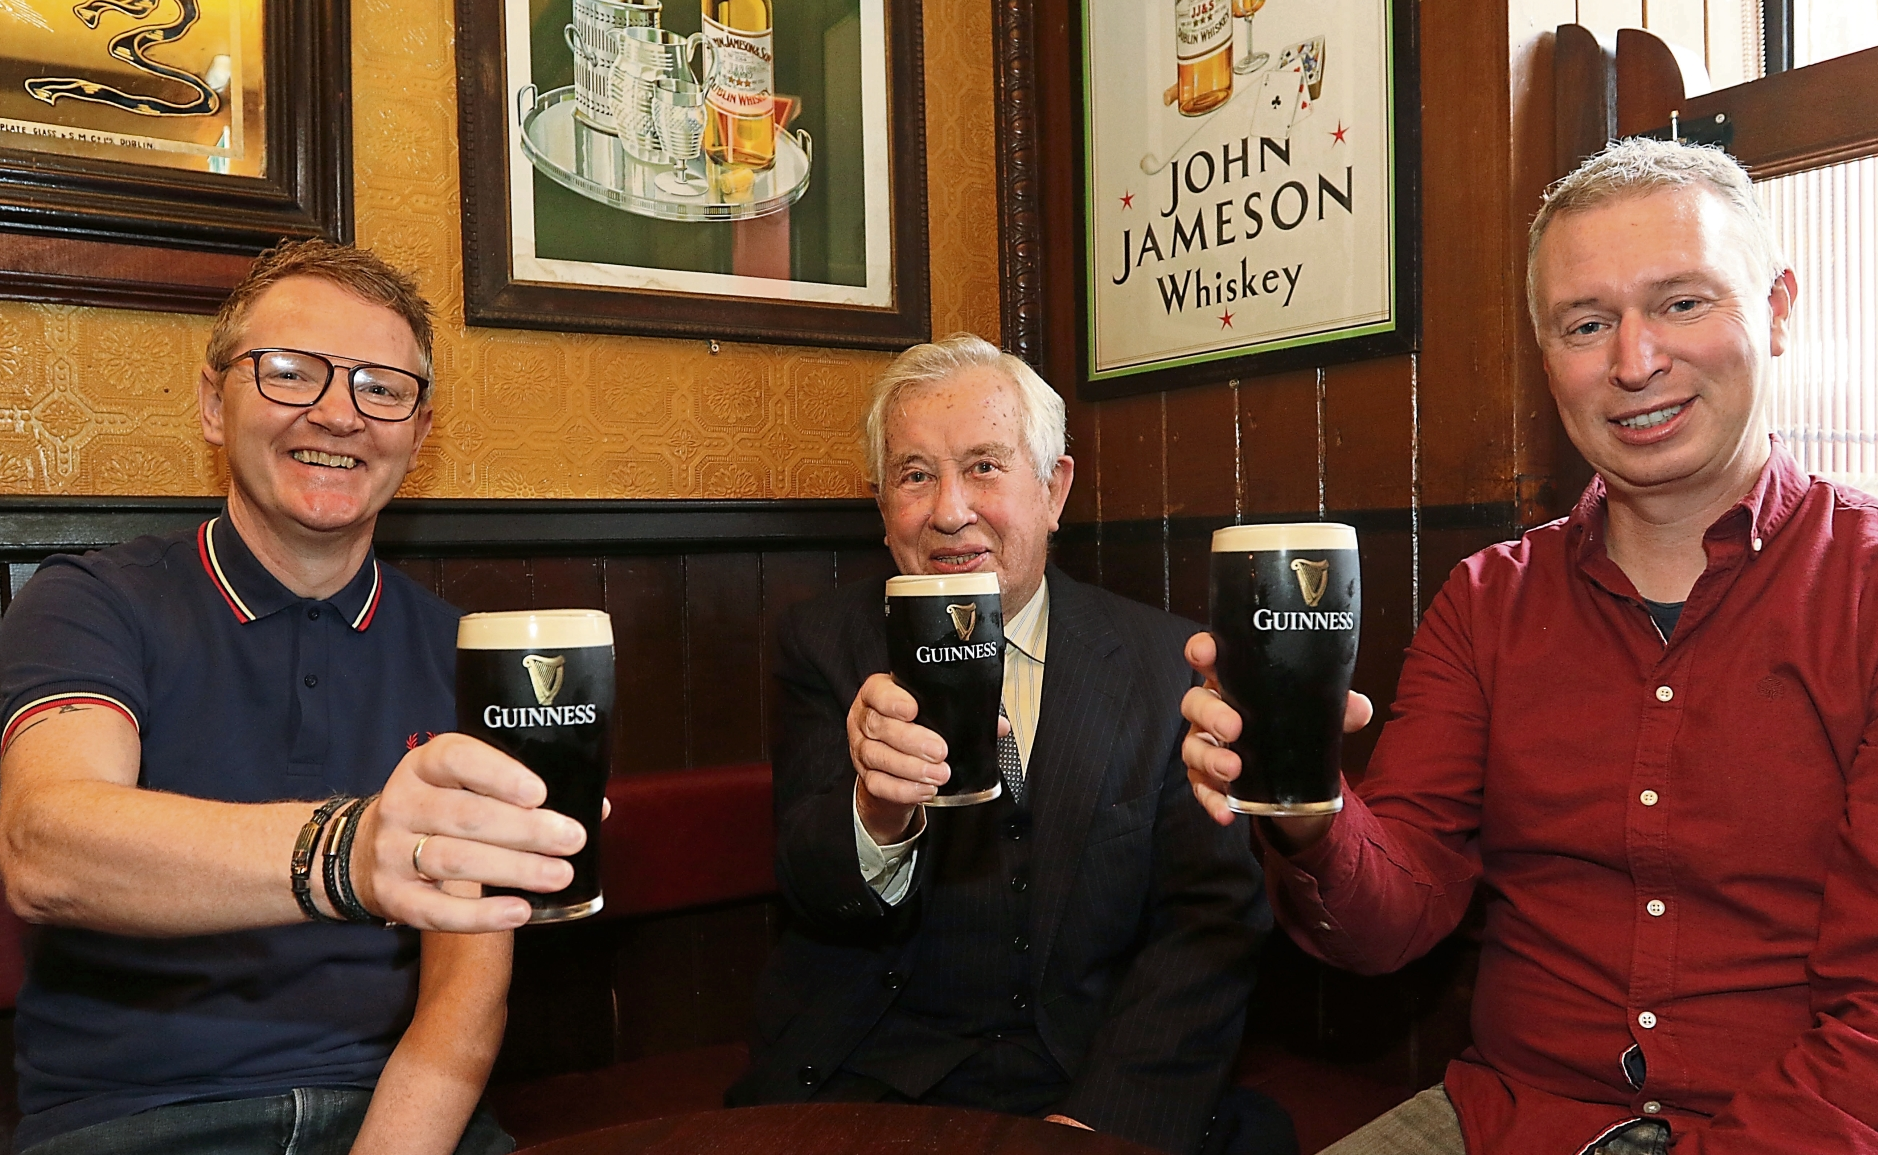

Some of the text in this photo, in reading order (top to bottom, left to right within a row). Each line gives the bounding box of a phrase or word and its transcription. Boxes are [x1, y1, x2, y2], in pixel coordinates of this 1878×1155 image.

[0, 123, 26, 134] PLATE
[33, 127, 57, 139] GLASS
[1161, 137, 1290, 218] JOHN
[1112, 165, 1353, 286] JAMESON
[1156, 256, 1303, 316] Whiskey
[1252, 608, 1354, 631] GUINNESS
[916, 641, 997, 663] GUINNESS
[483, 703, 597, 728] GUINNESS
